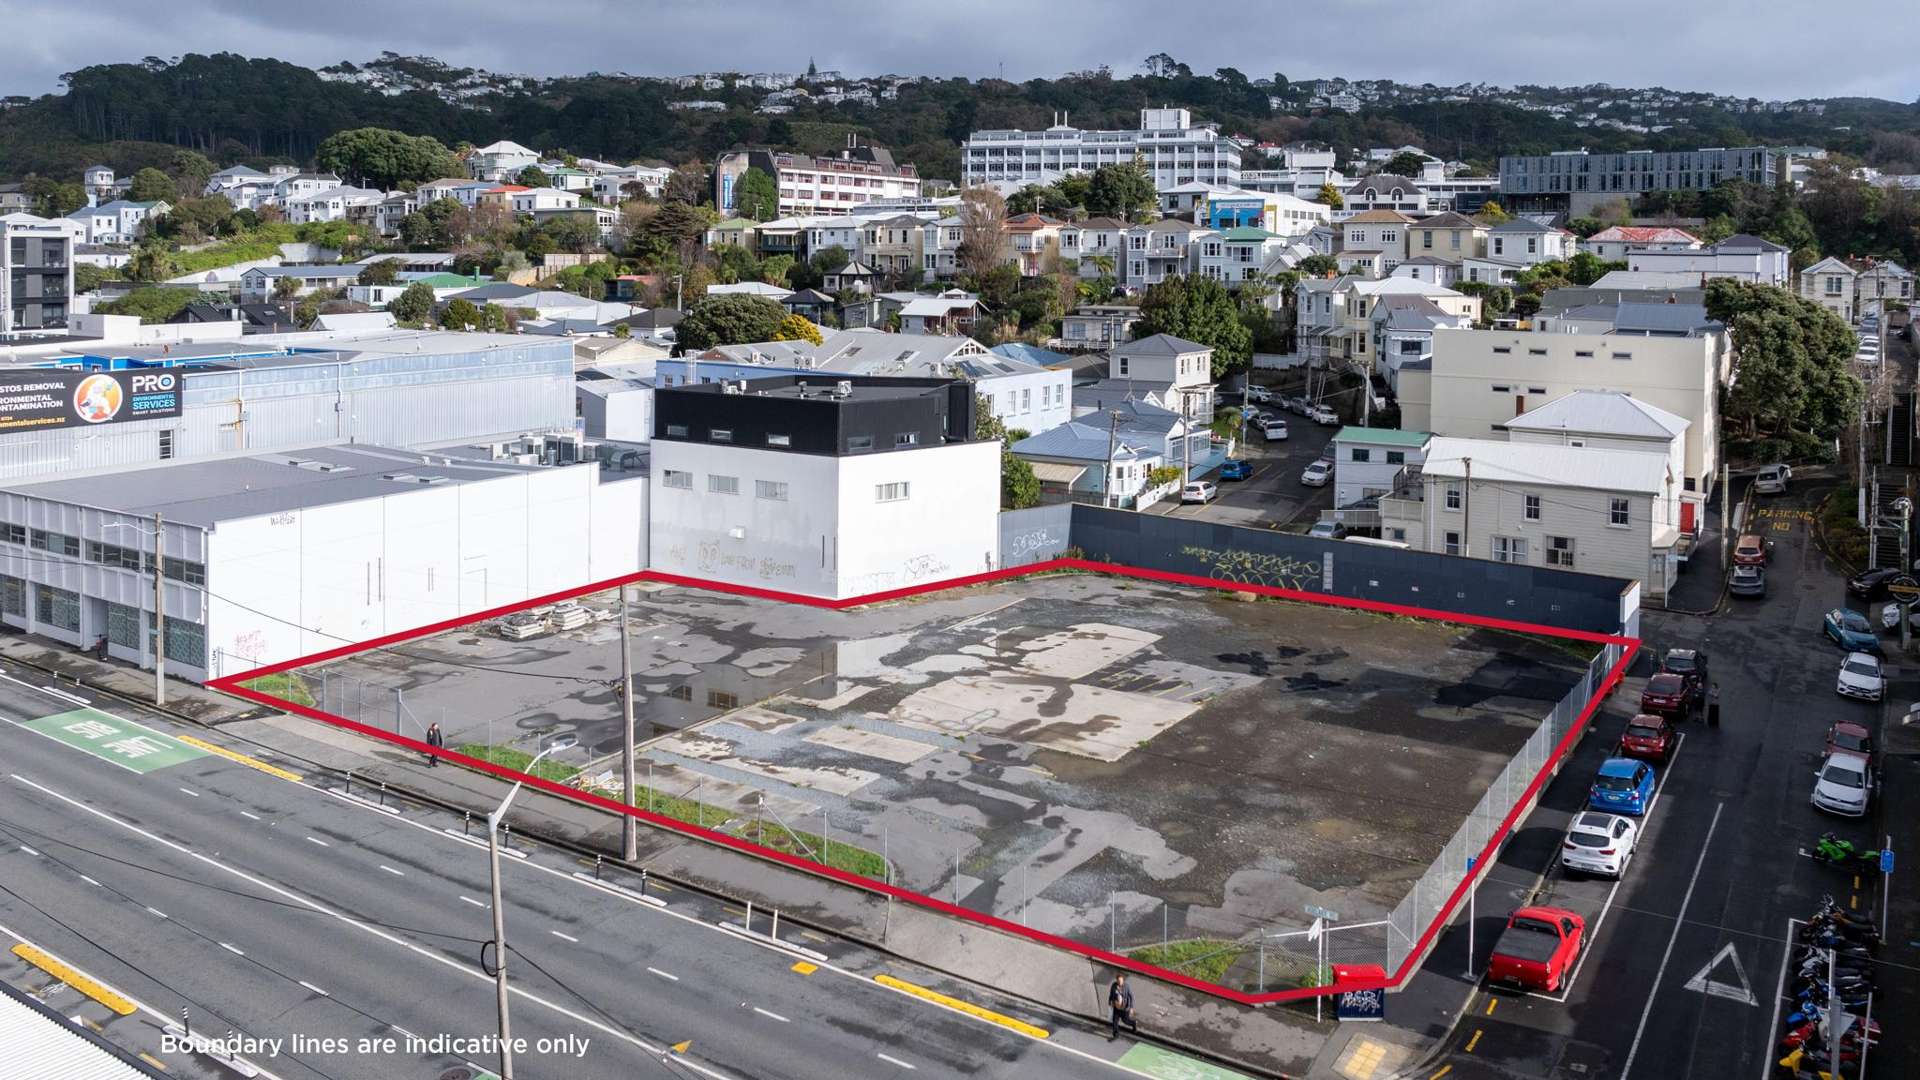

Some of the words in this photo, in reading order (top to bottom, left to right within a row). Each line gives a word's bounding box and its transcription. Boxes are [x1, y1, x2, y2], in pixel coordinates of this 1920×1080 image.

[23, 382, 66, 392] REMOVAL
[132, 373, 176, 393] PRO
[0, 400, 63, 411] NTAMINATION
[132, 399, 176, 410] SERVICES
[1758, 509, 1816, 525] PARKING
[1772, 521, 1791, 532] NO
